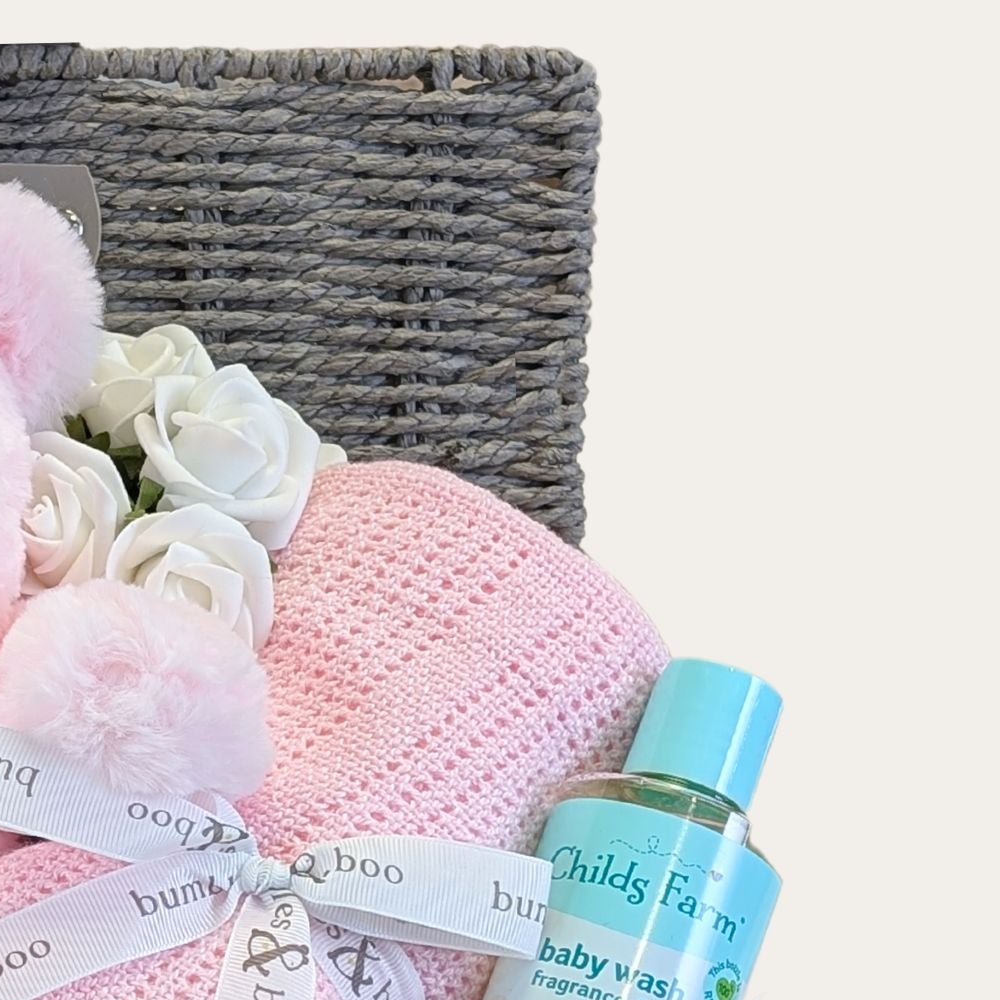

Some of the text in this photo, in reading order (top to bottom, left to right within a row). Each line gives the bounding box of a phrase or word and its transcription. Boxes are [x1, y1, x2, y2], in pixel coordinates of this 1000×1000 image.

[127, 802, 197, 847] boo
[332, 846, 404, 885] boo
[550, 845, 650, 905] Childs
[538, 937, 610, 981] baby
